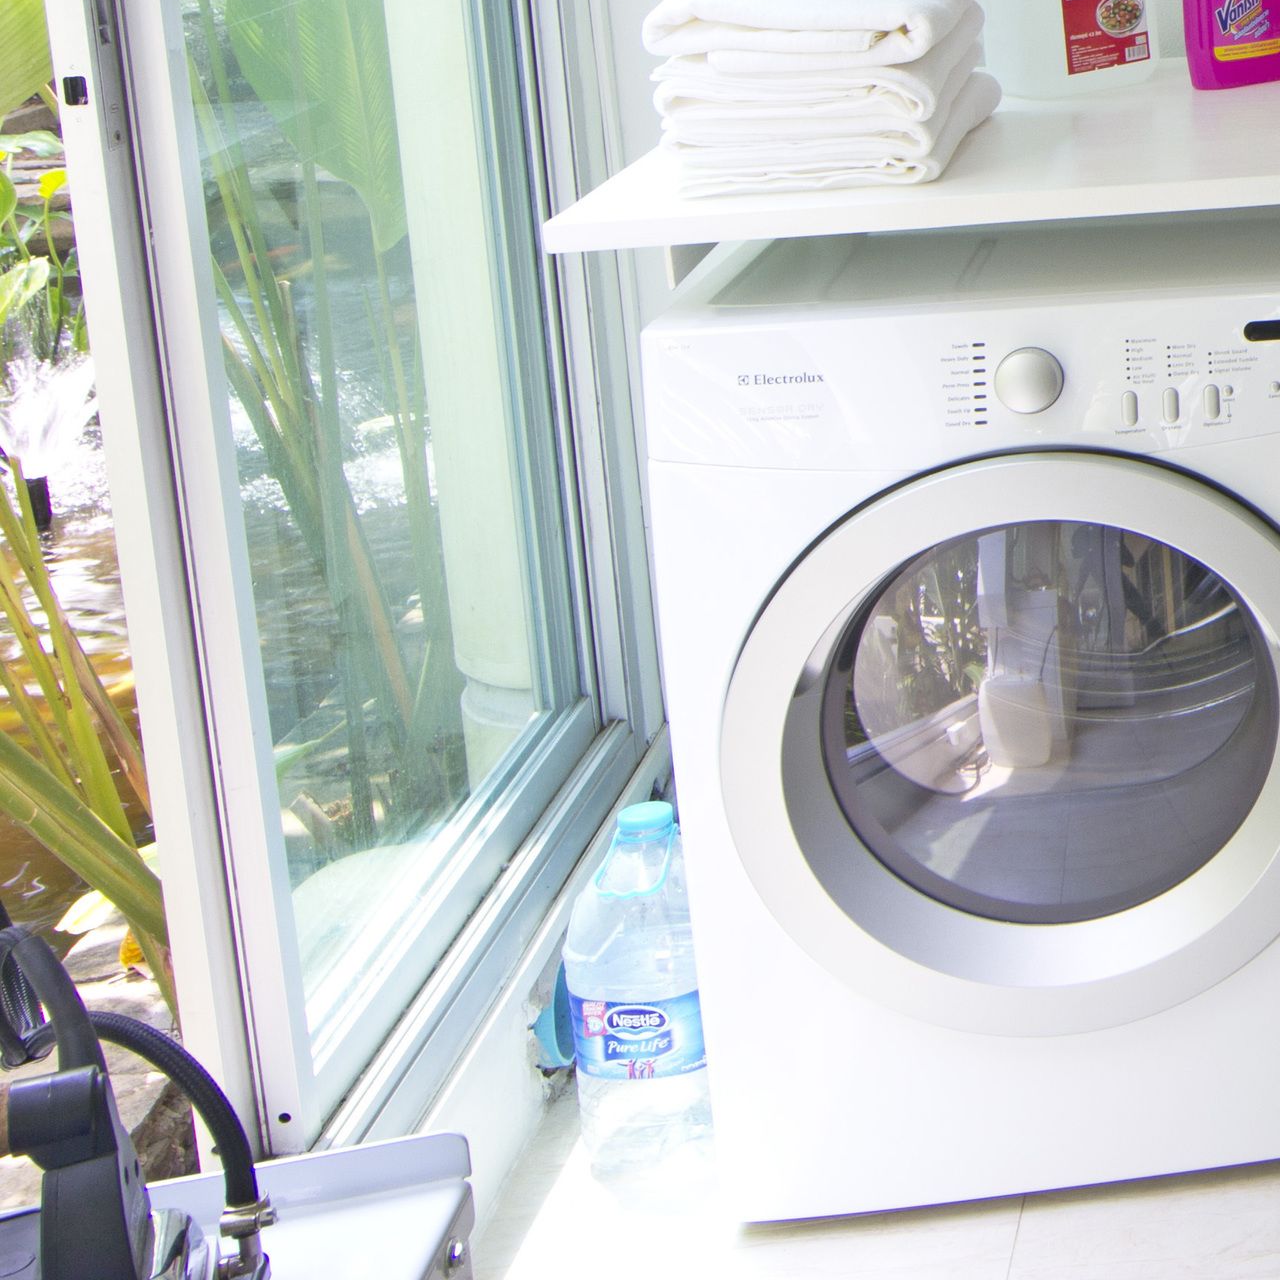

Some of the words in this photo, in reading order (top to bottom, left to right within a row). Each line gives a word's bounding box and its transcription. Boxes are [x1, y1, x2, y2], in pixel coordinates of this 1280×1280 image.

[754, 372, 825, 386] Electrolux
[1114, 427, 1147, 435] Temperature
[607, 1040, 639, 1055] Pure
[640, 1037, 669, 1052] Life
